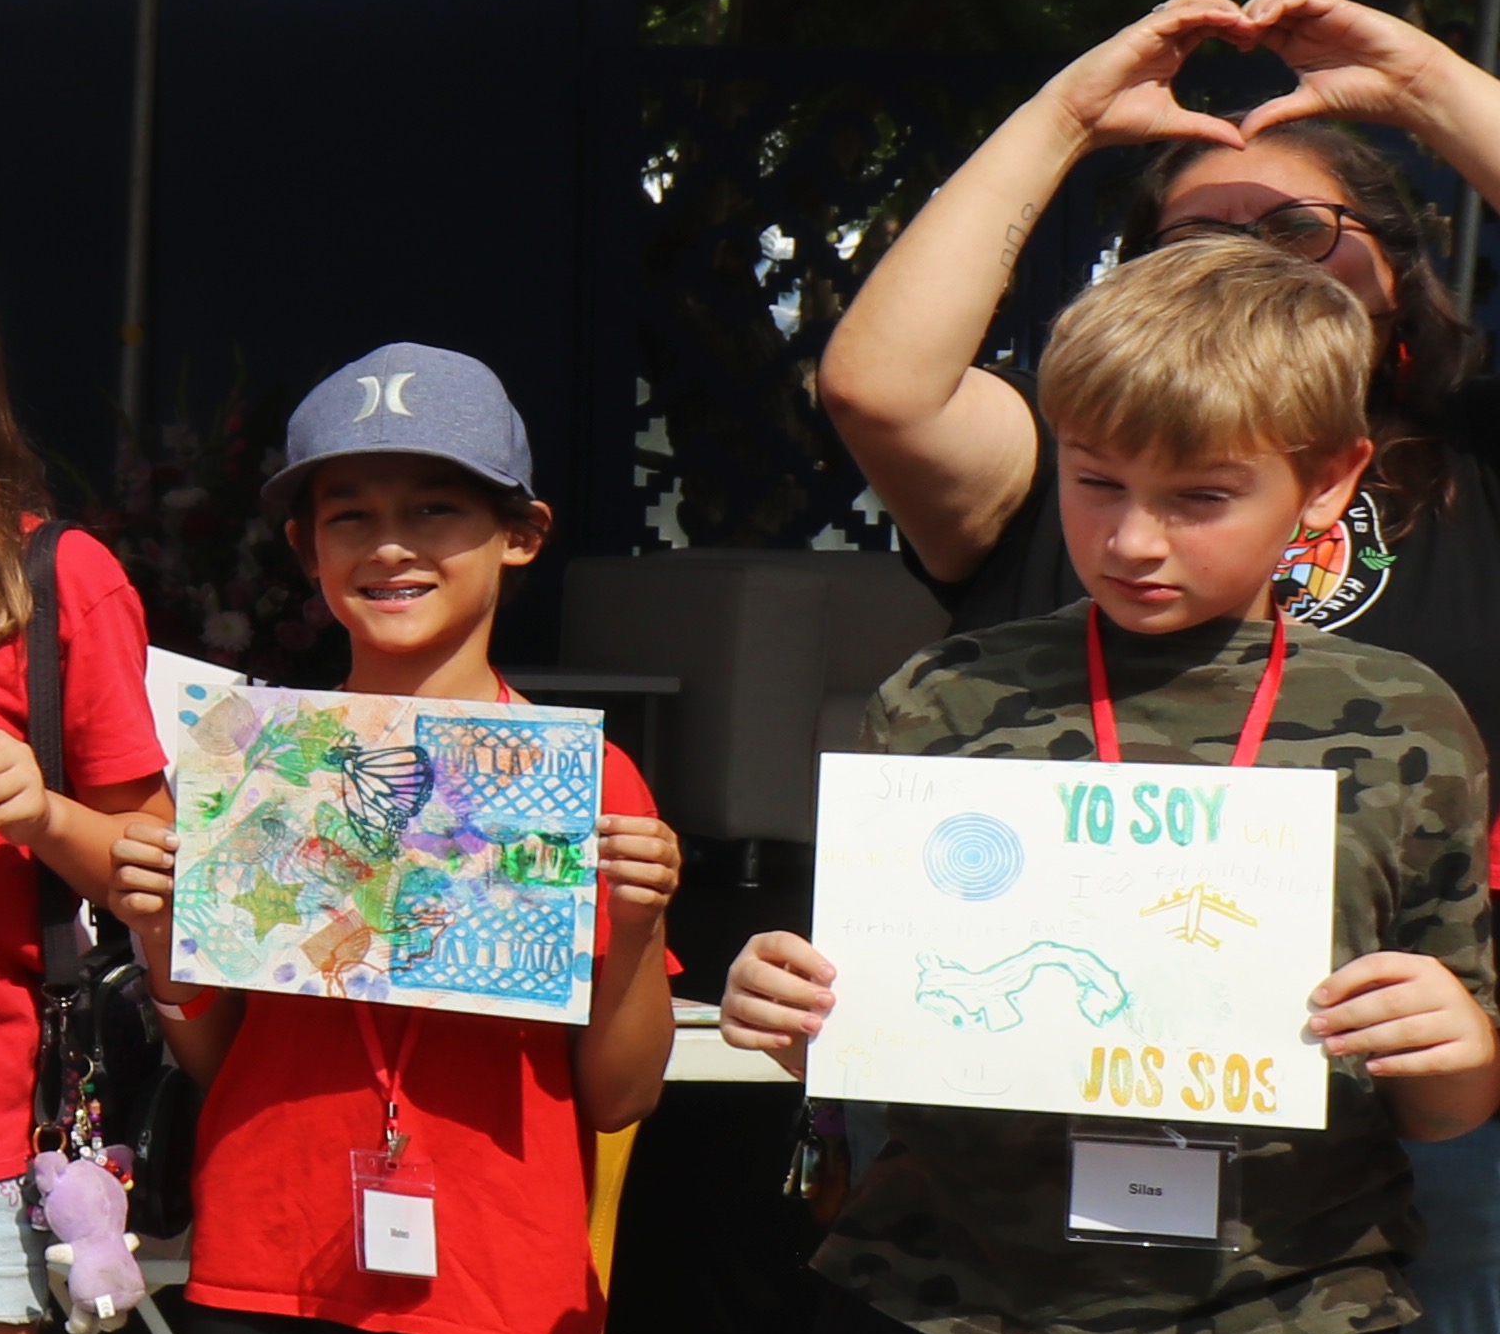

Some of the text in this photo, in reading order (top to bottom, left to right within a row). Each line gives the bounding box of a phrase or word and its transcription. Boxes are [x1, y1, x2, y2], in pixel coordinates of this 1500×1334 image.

[1055, 780, 1115, 845] YO
[1128, 781, 1233, 847] SOY
[1181, 1049, 1279, 1114] SOS
[1129, 1183, 1163, 1196] Silas
